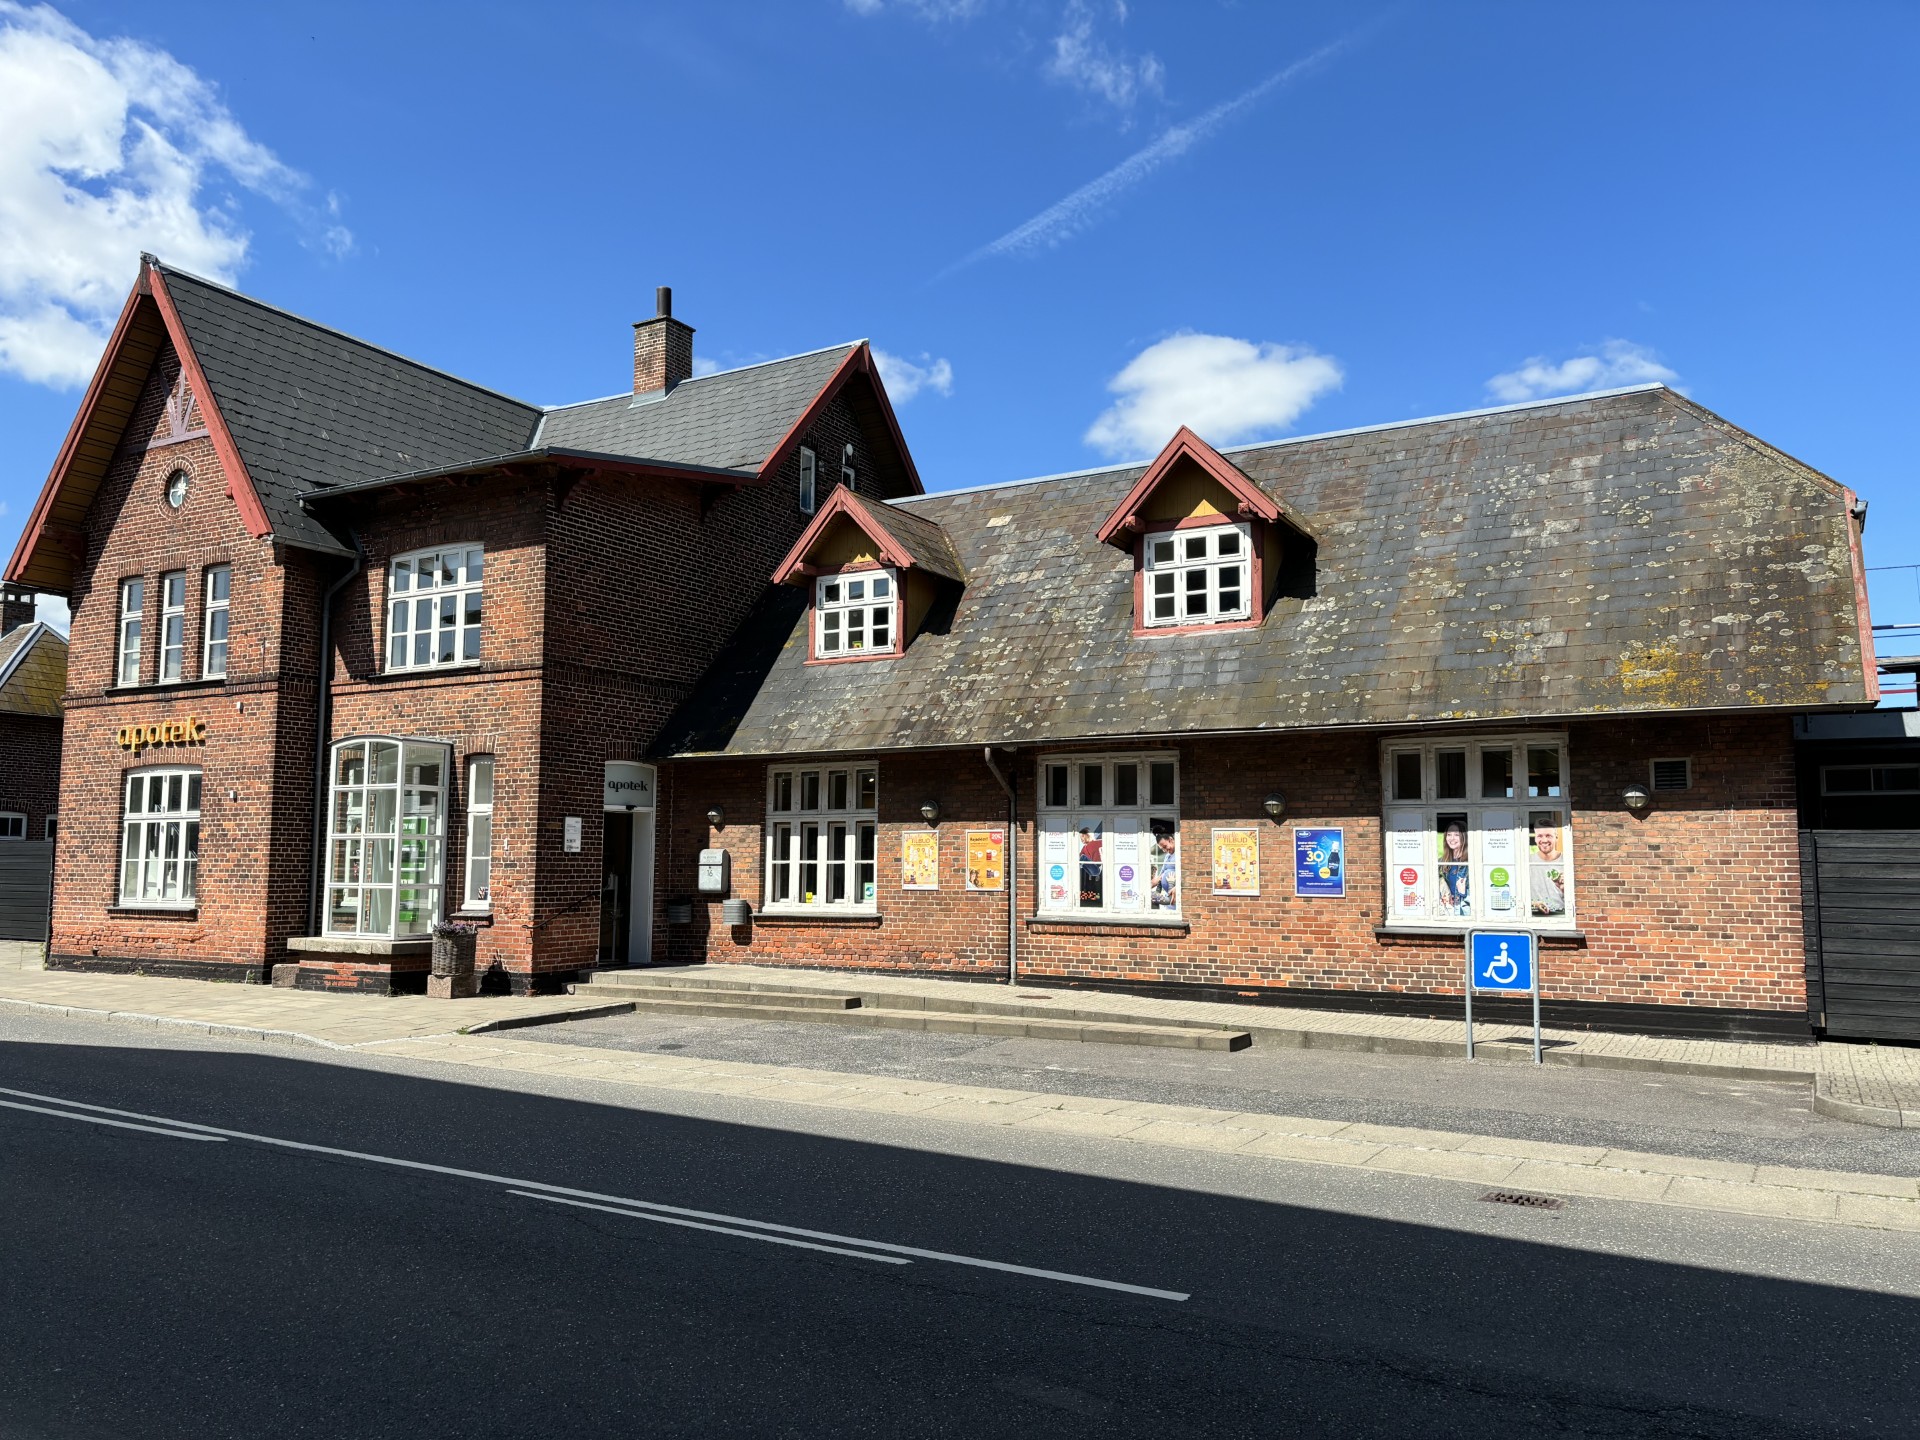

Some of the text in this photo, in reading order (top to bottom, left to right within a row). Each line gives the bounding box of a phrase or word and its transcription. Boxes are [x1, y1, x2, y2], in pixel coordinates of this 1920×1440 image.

[116, 716, 205, 752] apotek
[608, 780, 648, 792] apotek
[1306, 851, 1325, 862] 30
